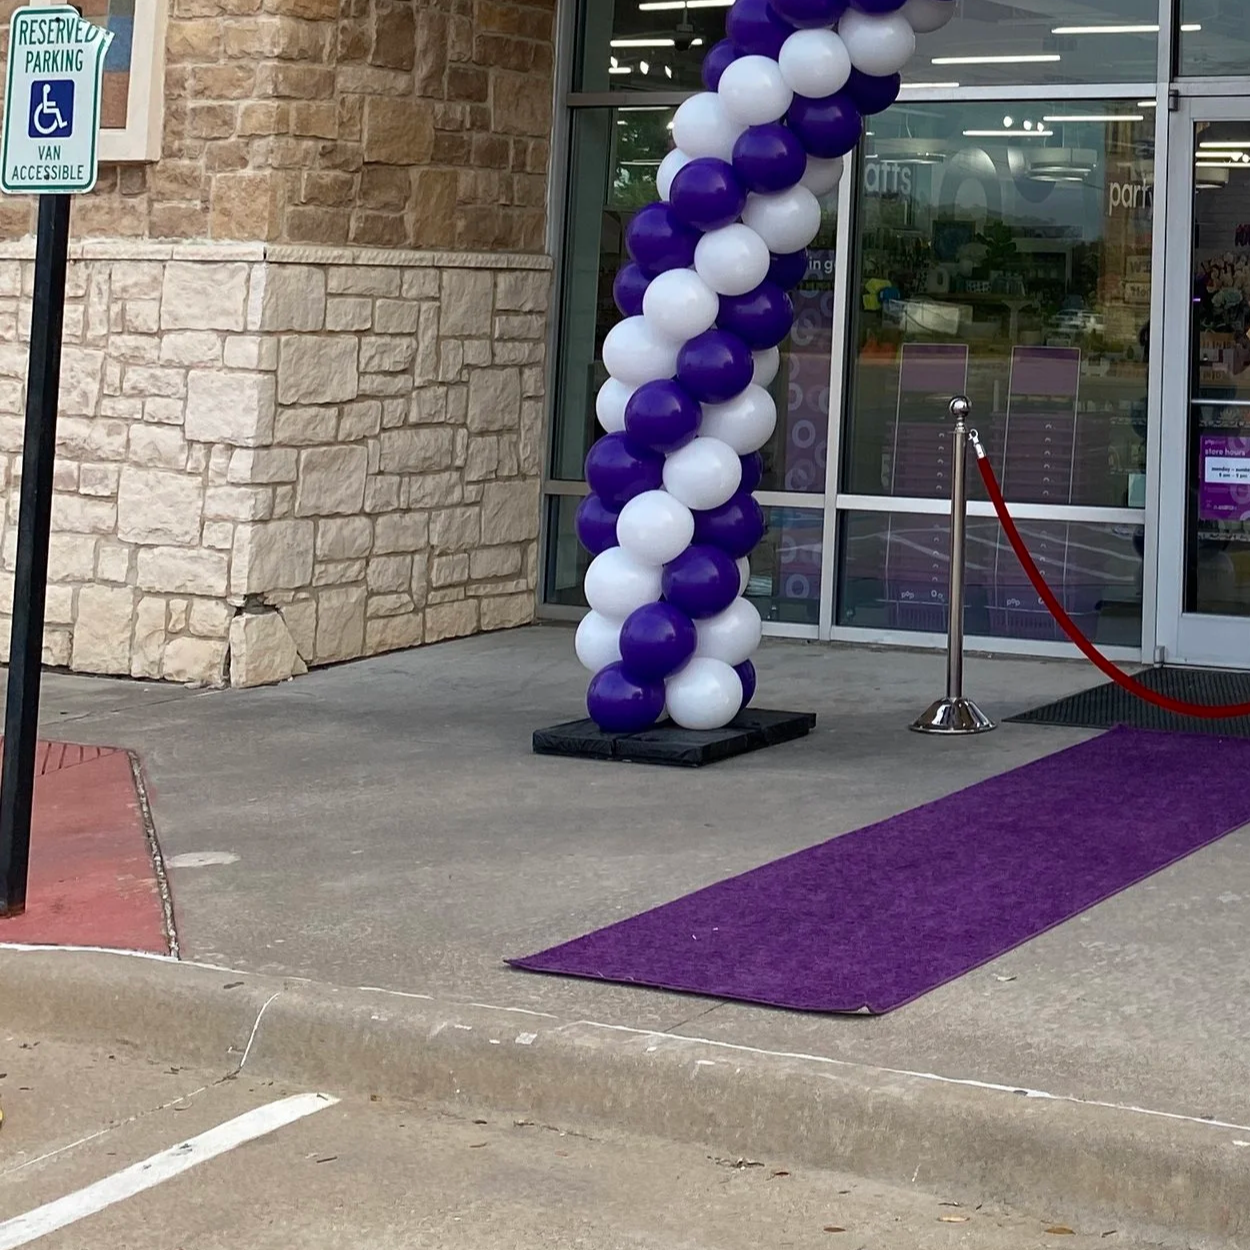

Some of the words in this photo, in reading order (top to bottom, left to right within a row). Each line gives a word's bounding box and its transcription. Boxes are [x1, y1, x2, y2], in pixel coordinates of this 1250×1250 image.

[19, 17, 99, 45] RESERVED
[25, 49, 84, 73] PARKING
[38, 145, 61, 160] VAN
[12, 165, 84, 180] ACCESSIBLE
